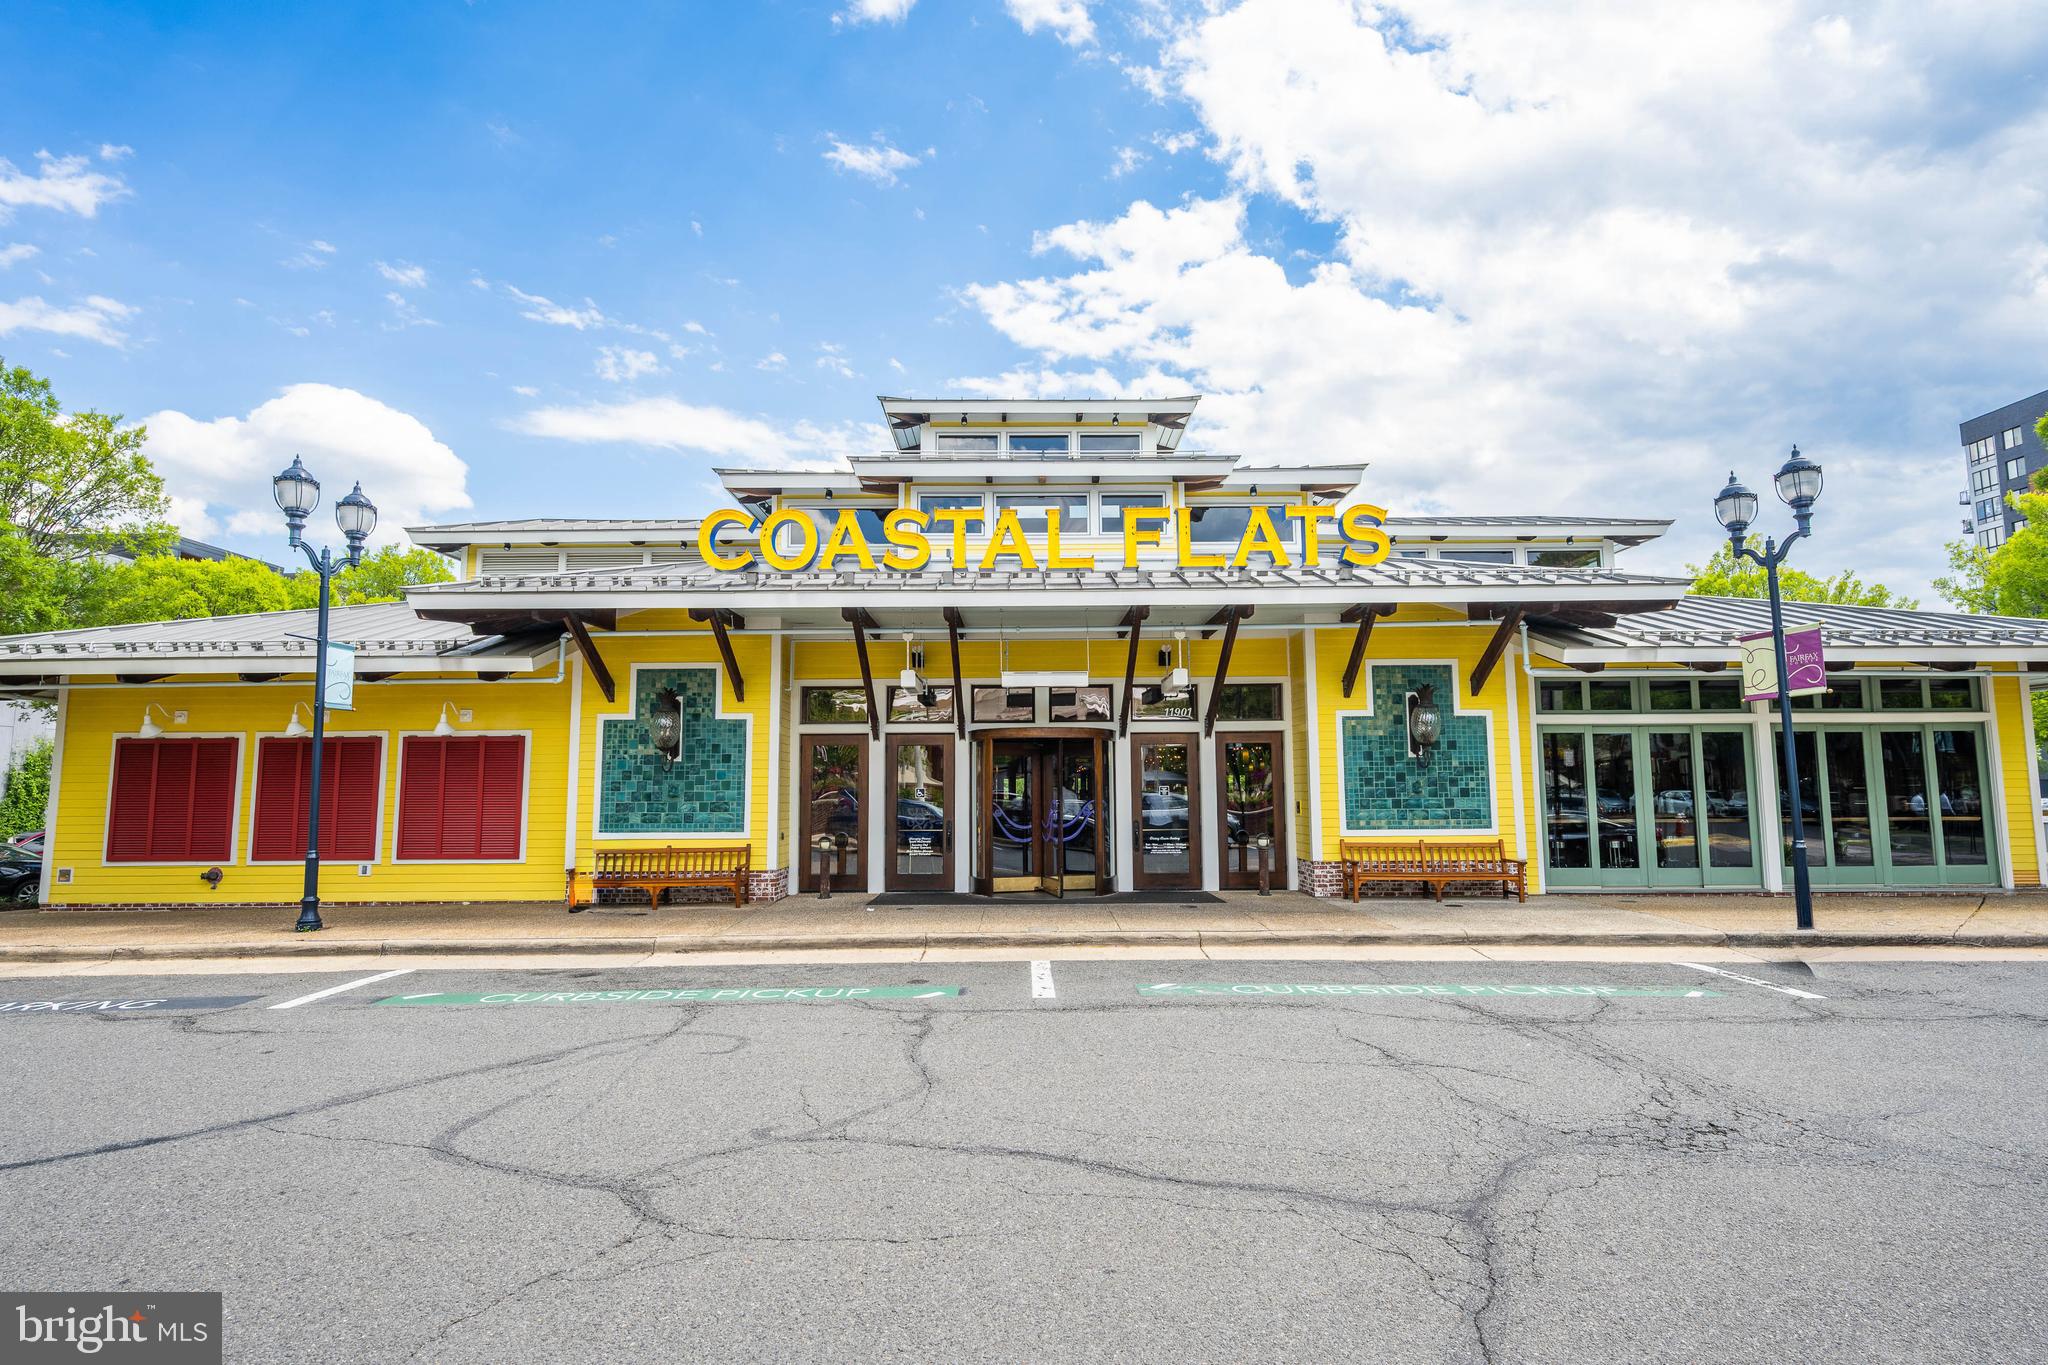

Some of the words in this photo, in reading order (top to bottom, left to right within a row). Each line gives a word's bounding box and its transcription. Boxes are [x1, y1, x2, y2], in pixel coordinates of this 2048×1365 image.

[698, 508, 1095, 572] COASTAL
[1122, 504, 1391, 571] FLATS
[1789, 652, 1818, 663] FAIRFAX
[1165, 707, 1192, 717] 11901
[1231, 984, 1457, 995] CURBSIDE
[1461, 985, 1617, 995] PICKUP
[479, 990, 704, 1003] CURBSIDE
[712, 988, 871, 999] PICKUP
